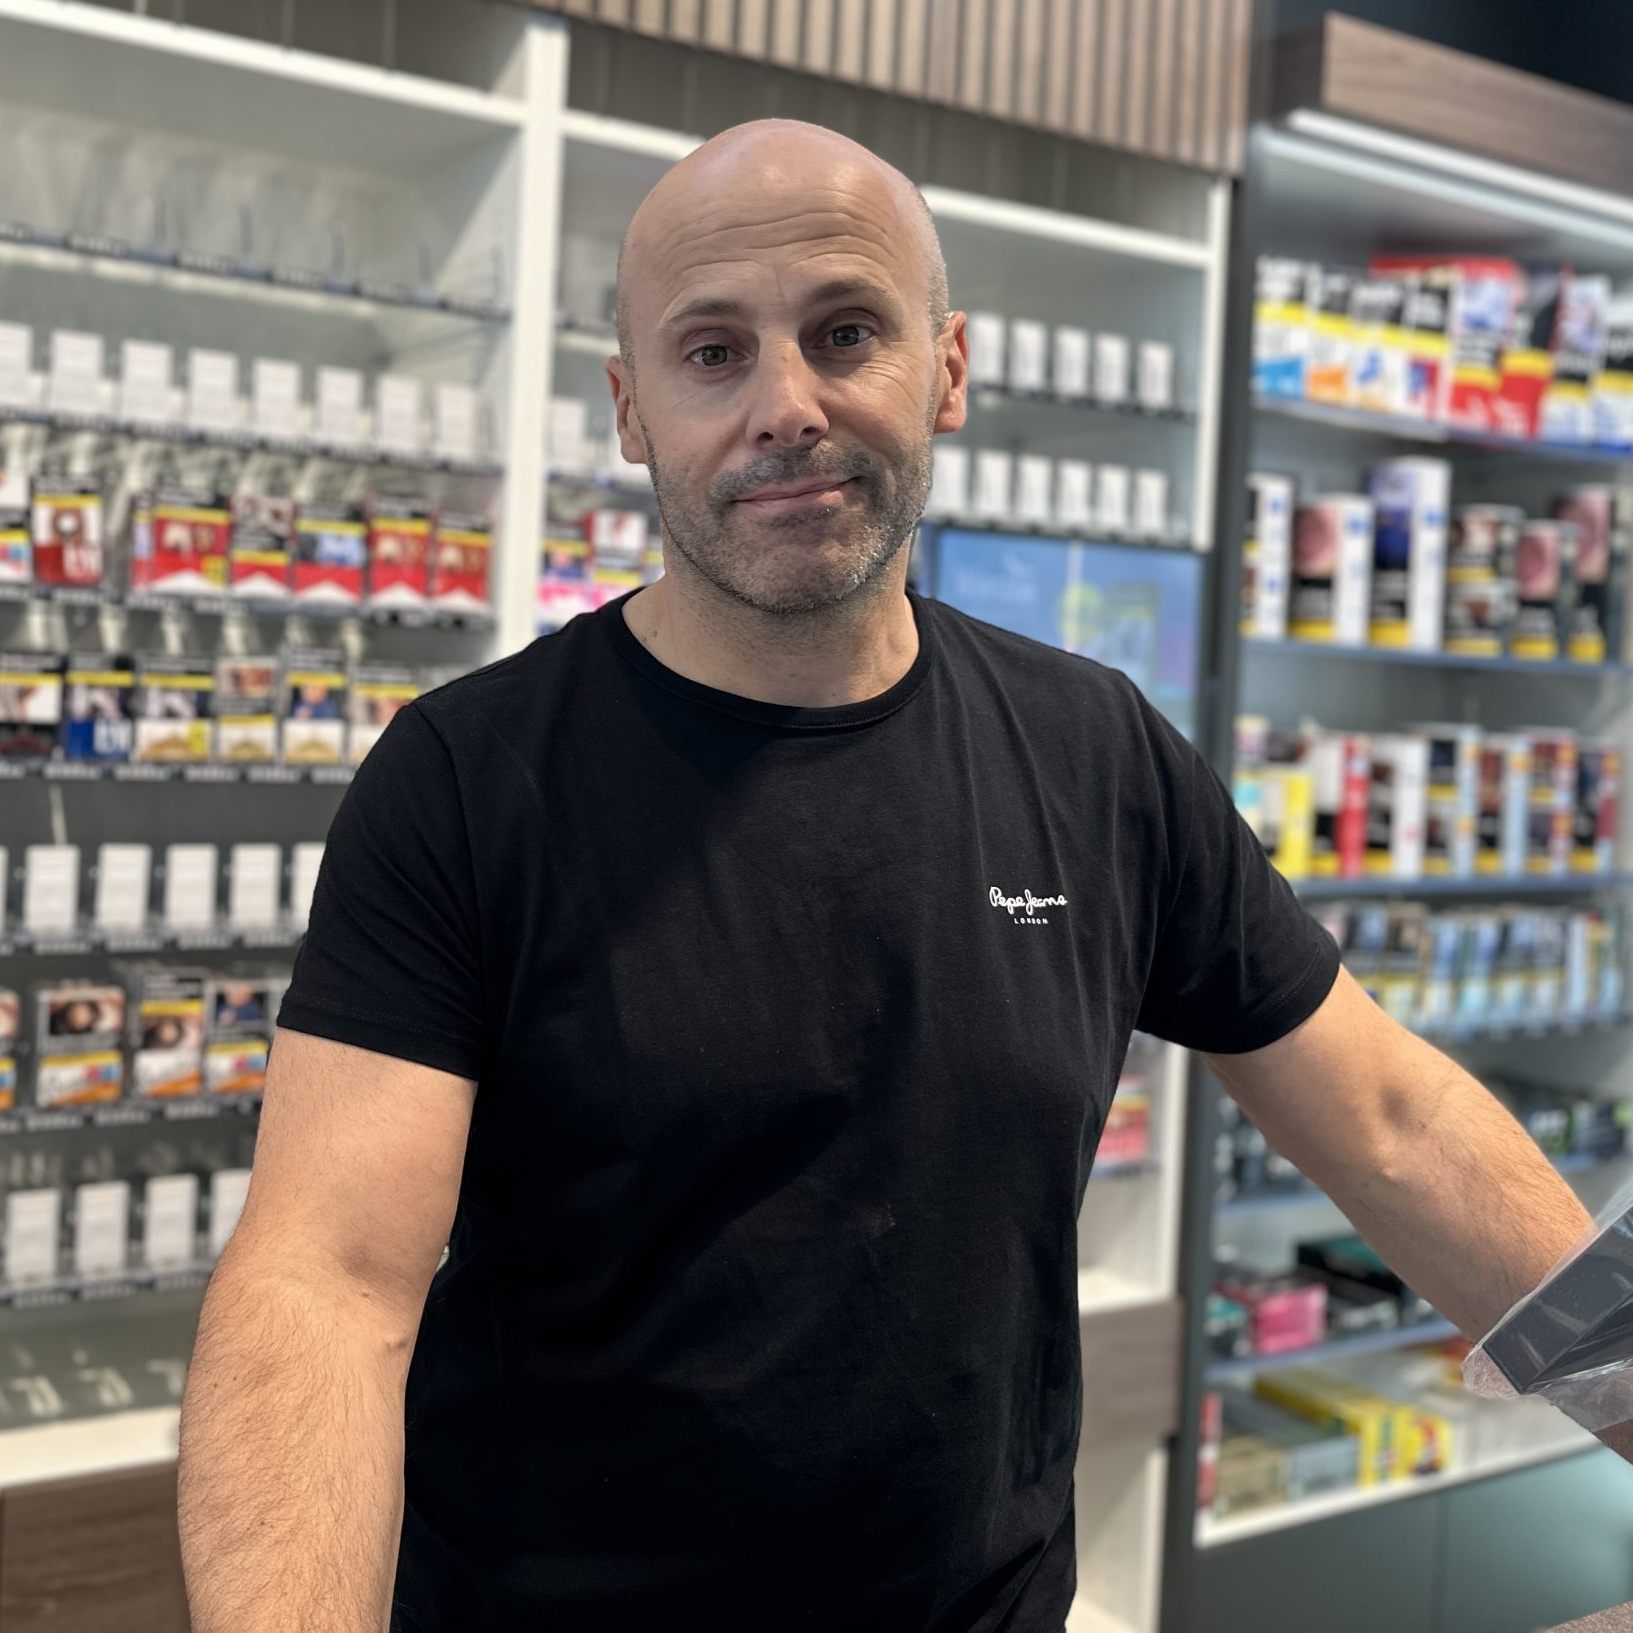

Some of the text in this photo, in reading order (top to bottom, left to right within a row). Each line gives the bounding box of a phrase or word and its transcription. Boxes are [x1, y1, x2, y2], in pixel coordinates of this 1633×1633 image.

[989, 886, 1068, 916] Pepe Jeans
[1013, 917, 1049, 925] LONDON
